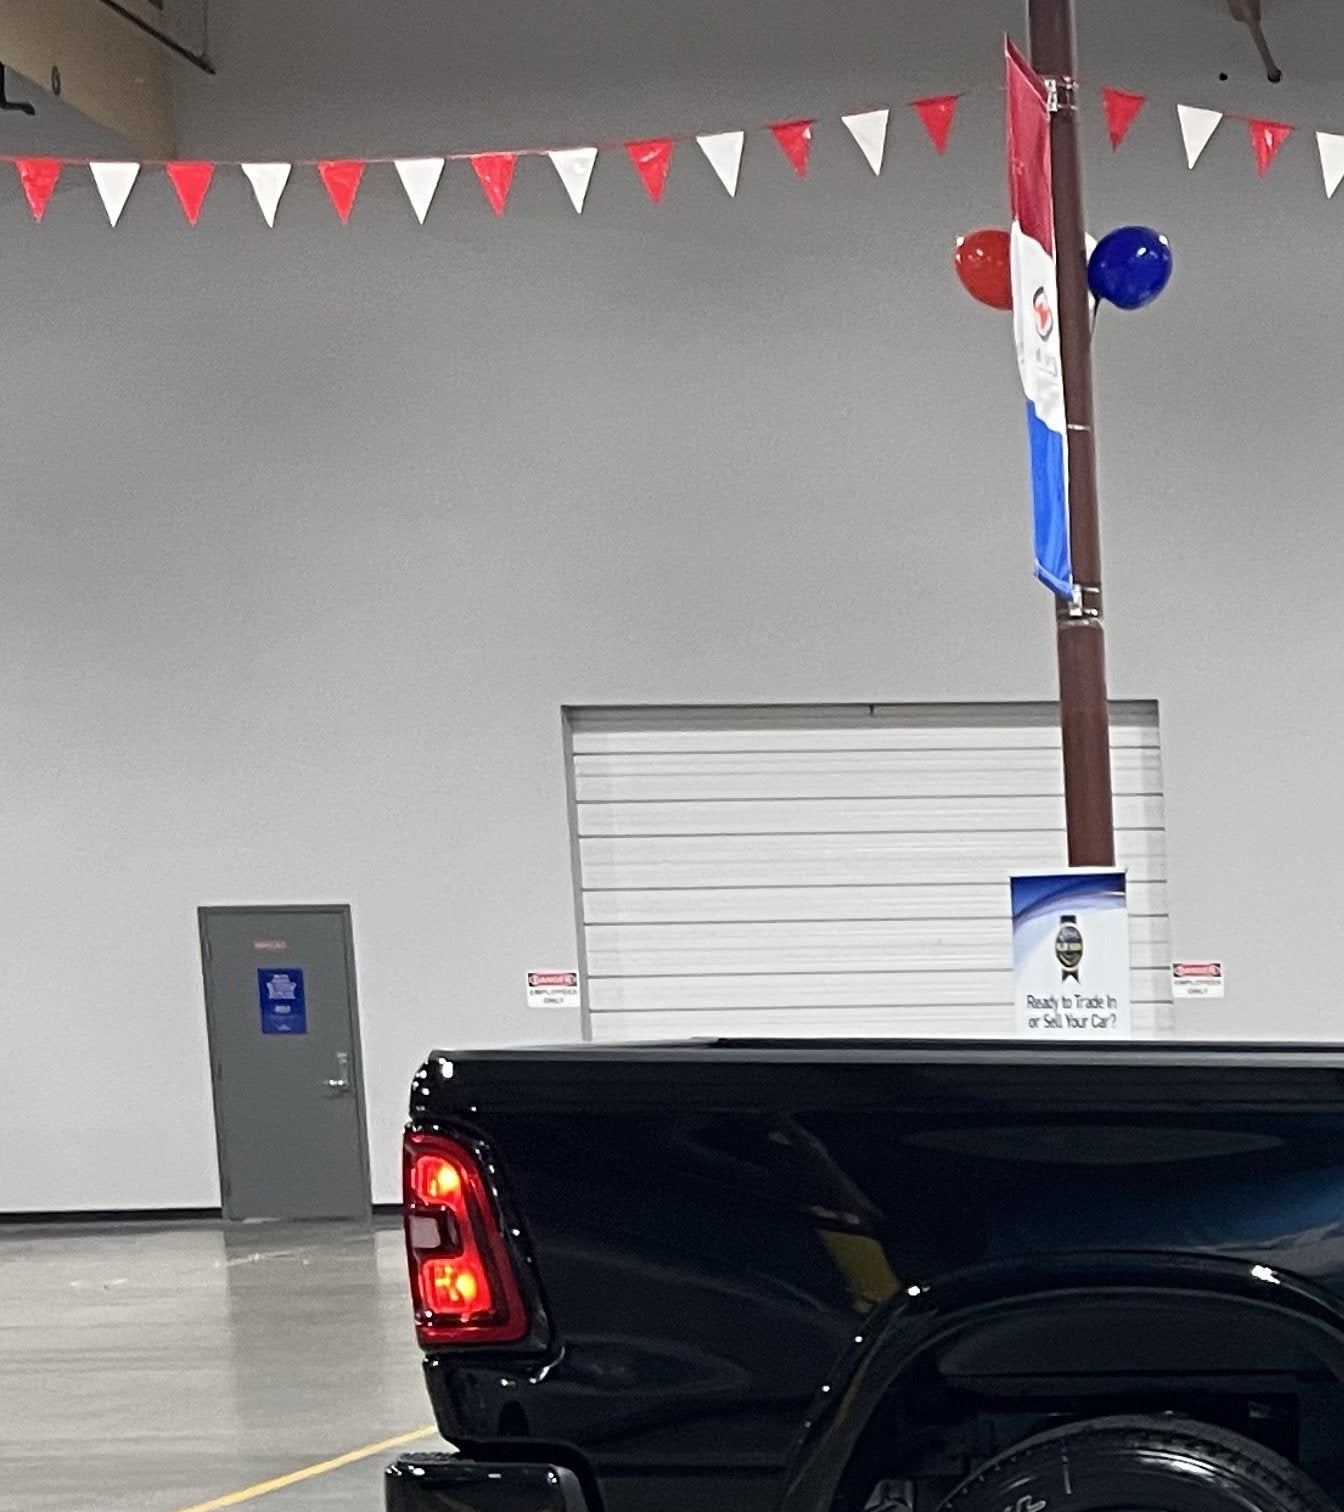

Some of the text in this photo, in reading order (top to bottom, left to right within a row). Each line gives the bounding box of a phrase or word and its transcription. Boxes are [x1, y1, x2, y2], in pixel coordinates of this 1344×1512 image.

[1026, 994, 1117, 1013] Ready to Trade In
[1028, 1013, 1117, 1029] or Sell Your Car?
